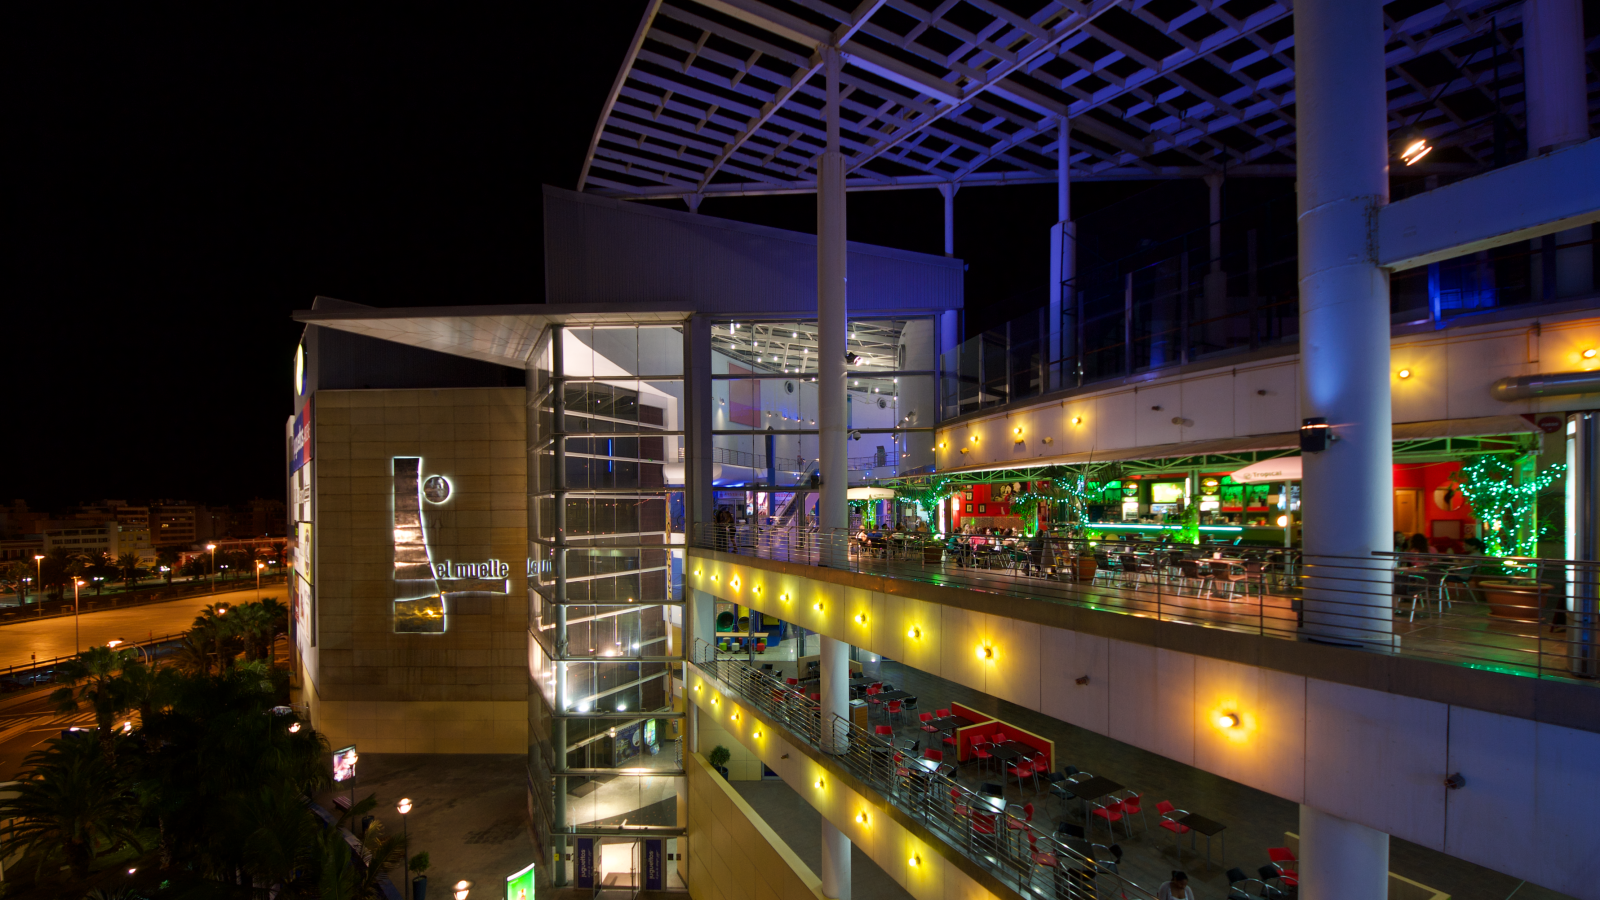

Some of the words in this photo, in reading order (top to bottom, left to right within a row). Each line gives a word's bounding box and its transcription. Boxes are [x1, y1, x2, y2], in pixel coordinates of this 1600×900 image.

[1253, 470, 1282, 478] Tropical
[436, 560, 450, 578] el
[454, 559, 509, 578] muelle
